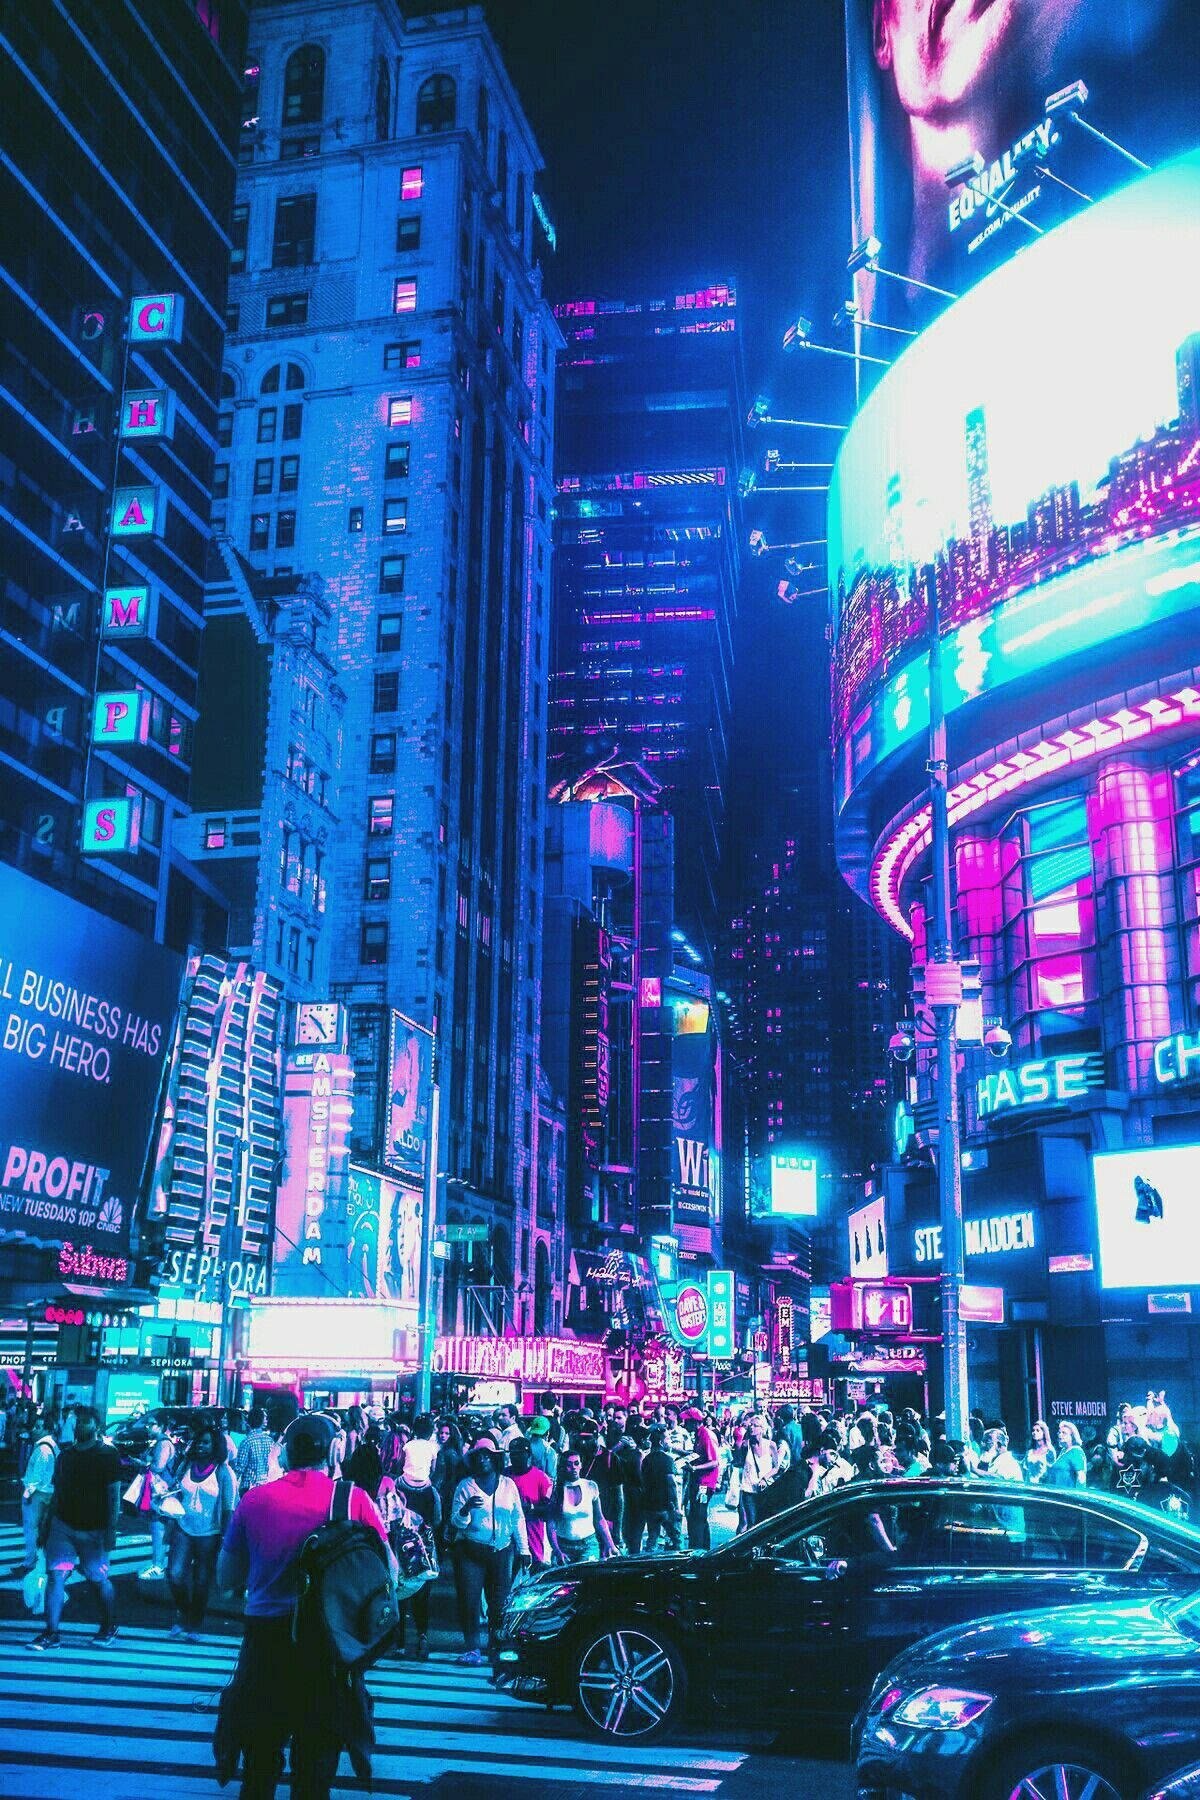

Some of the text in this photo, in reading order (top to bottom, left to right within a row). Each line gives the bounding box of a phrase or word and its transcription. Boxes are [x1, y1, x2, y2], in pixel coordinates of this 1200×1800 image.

[94, 302, 166, 841] CHAMPS
[19, 969, 120, 1040] BUSINESS
[122, 1012, 161, 1057] HAS
[3, 1013, 111, 1084] BIG HERO.
[303, 1054, 332, 1264] AMSTERDAM
[395, 1130, 420, 1151] ALDO
[1, 1145, 110, 1206] PROFIT
[25, 1198, 77, 1224] TUESDAYS
[79, 1210, 96, 1227] 10P
[97, 1221, 121, 1234] CNBC
[915, 1212, 1035, 1262] STE MADDEN
[151, 1358, 192, 1366] SEPHORA
[1052, 1401, 1107, 1416] STEVE MADDEN
